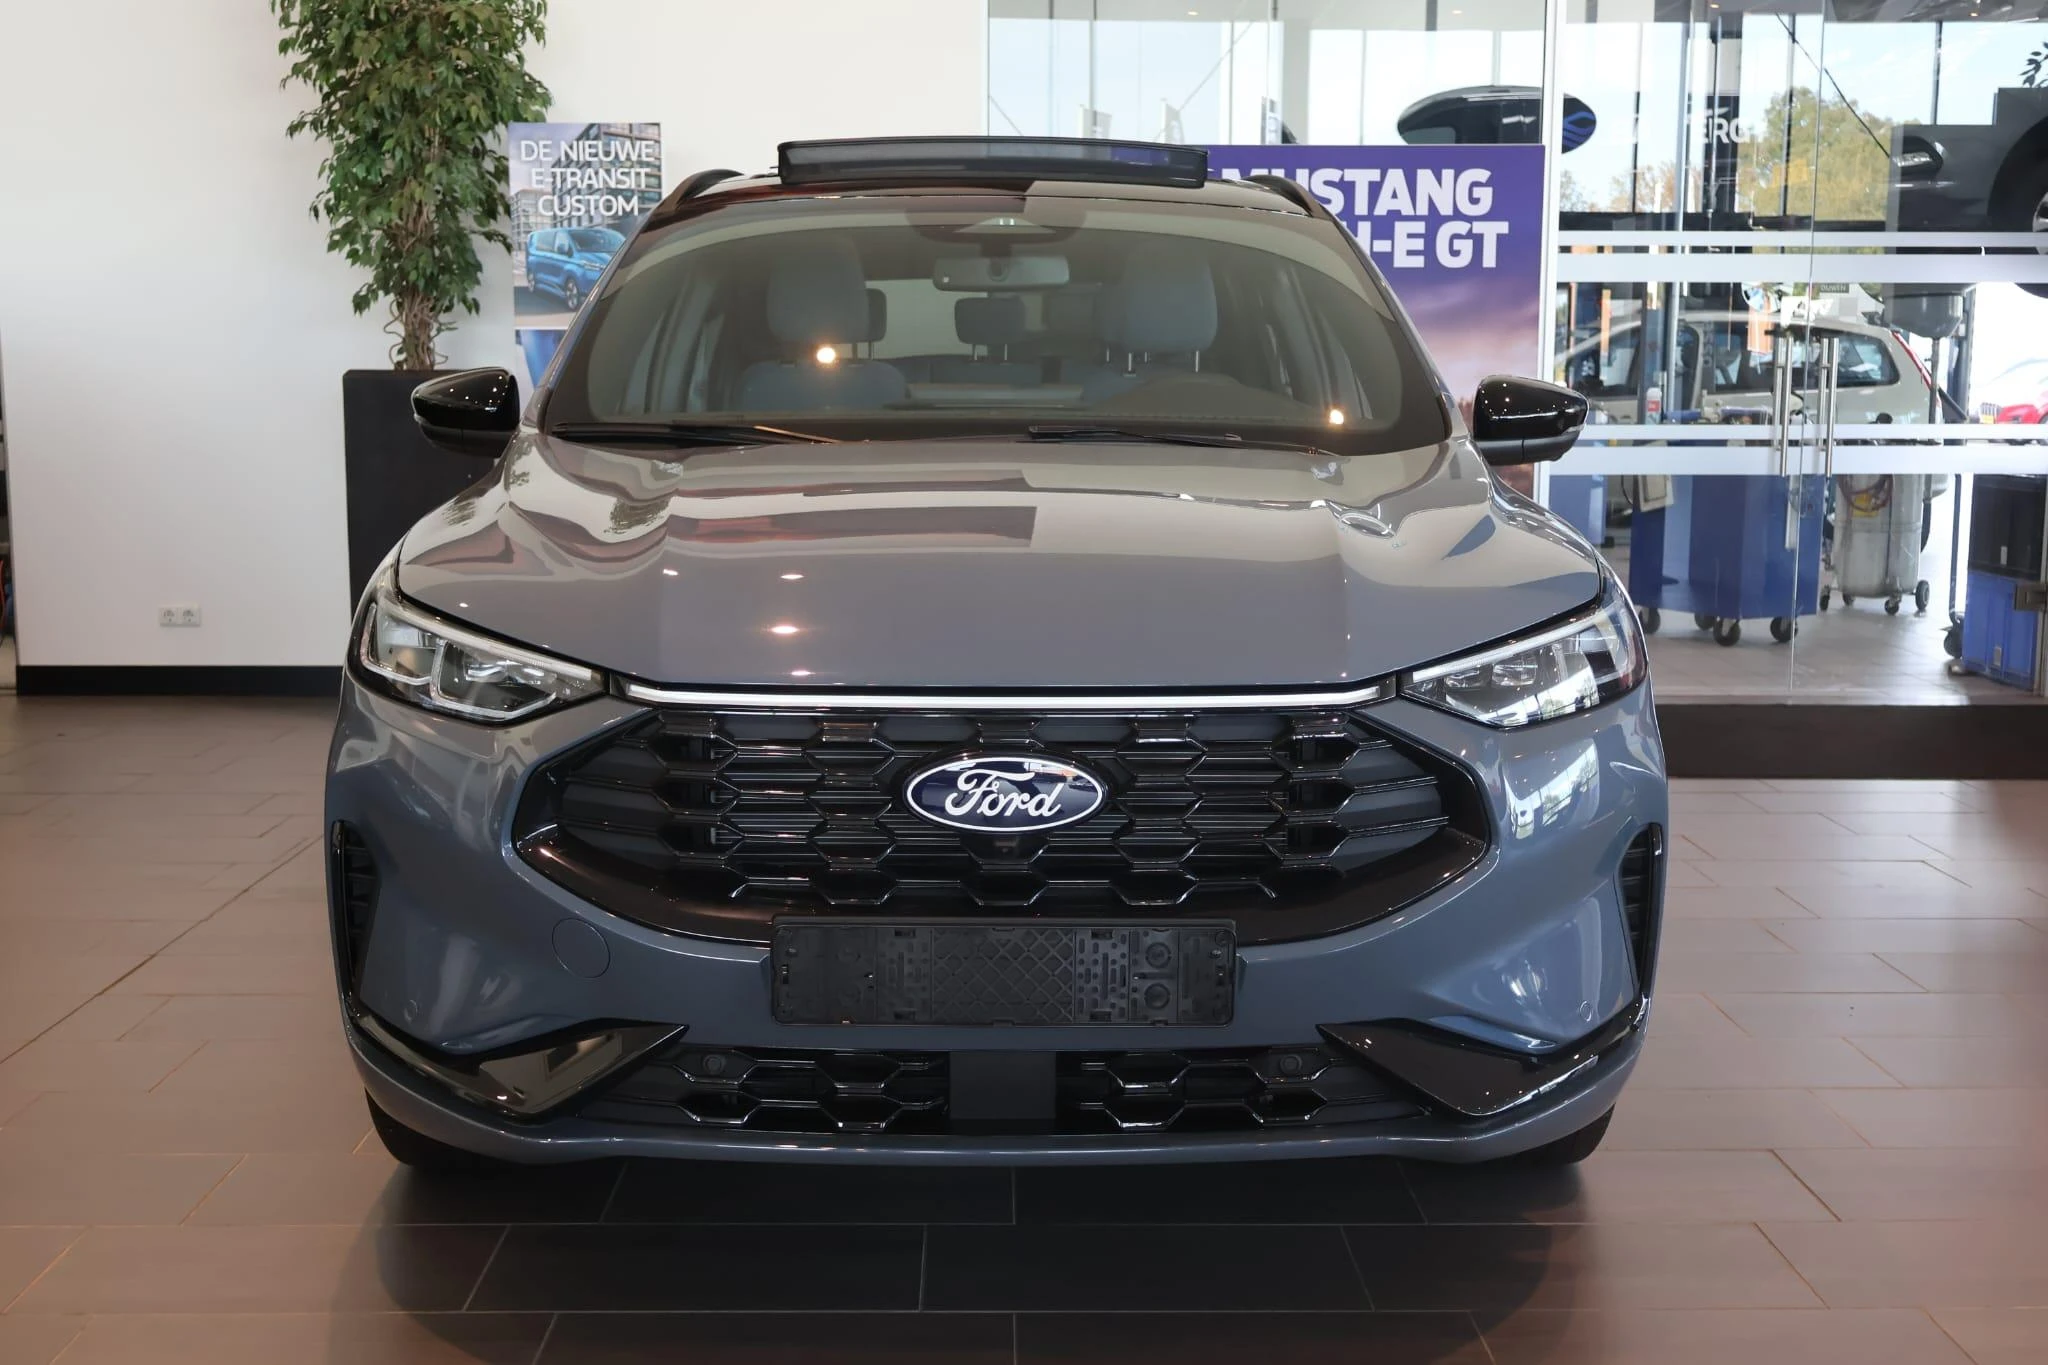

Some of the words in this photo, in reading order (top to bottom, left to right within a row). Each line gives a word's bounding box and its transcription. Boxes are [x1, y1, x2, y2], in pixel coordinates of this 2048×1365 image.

[520, 140, 552, 161] DE
[561, 140, 655, 161] NIEUWE
[531, 168, 648, 189] E-TRANSIT
[537, 195, 639, 217] CUSTOM
[1436, 220, 1509, 268] GT
[945, 769, 1065, 817] Ford
